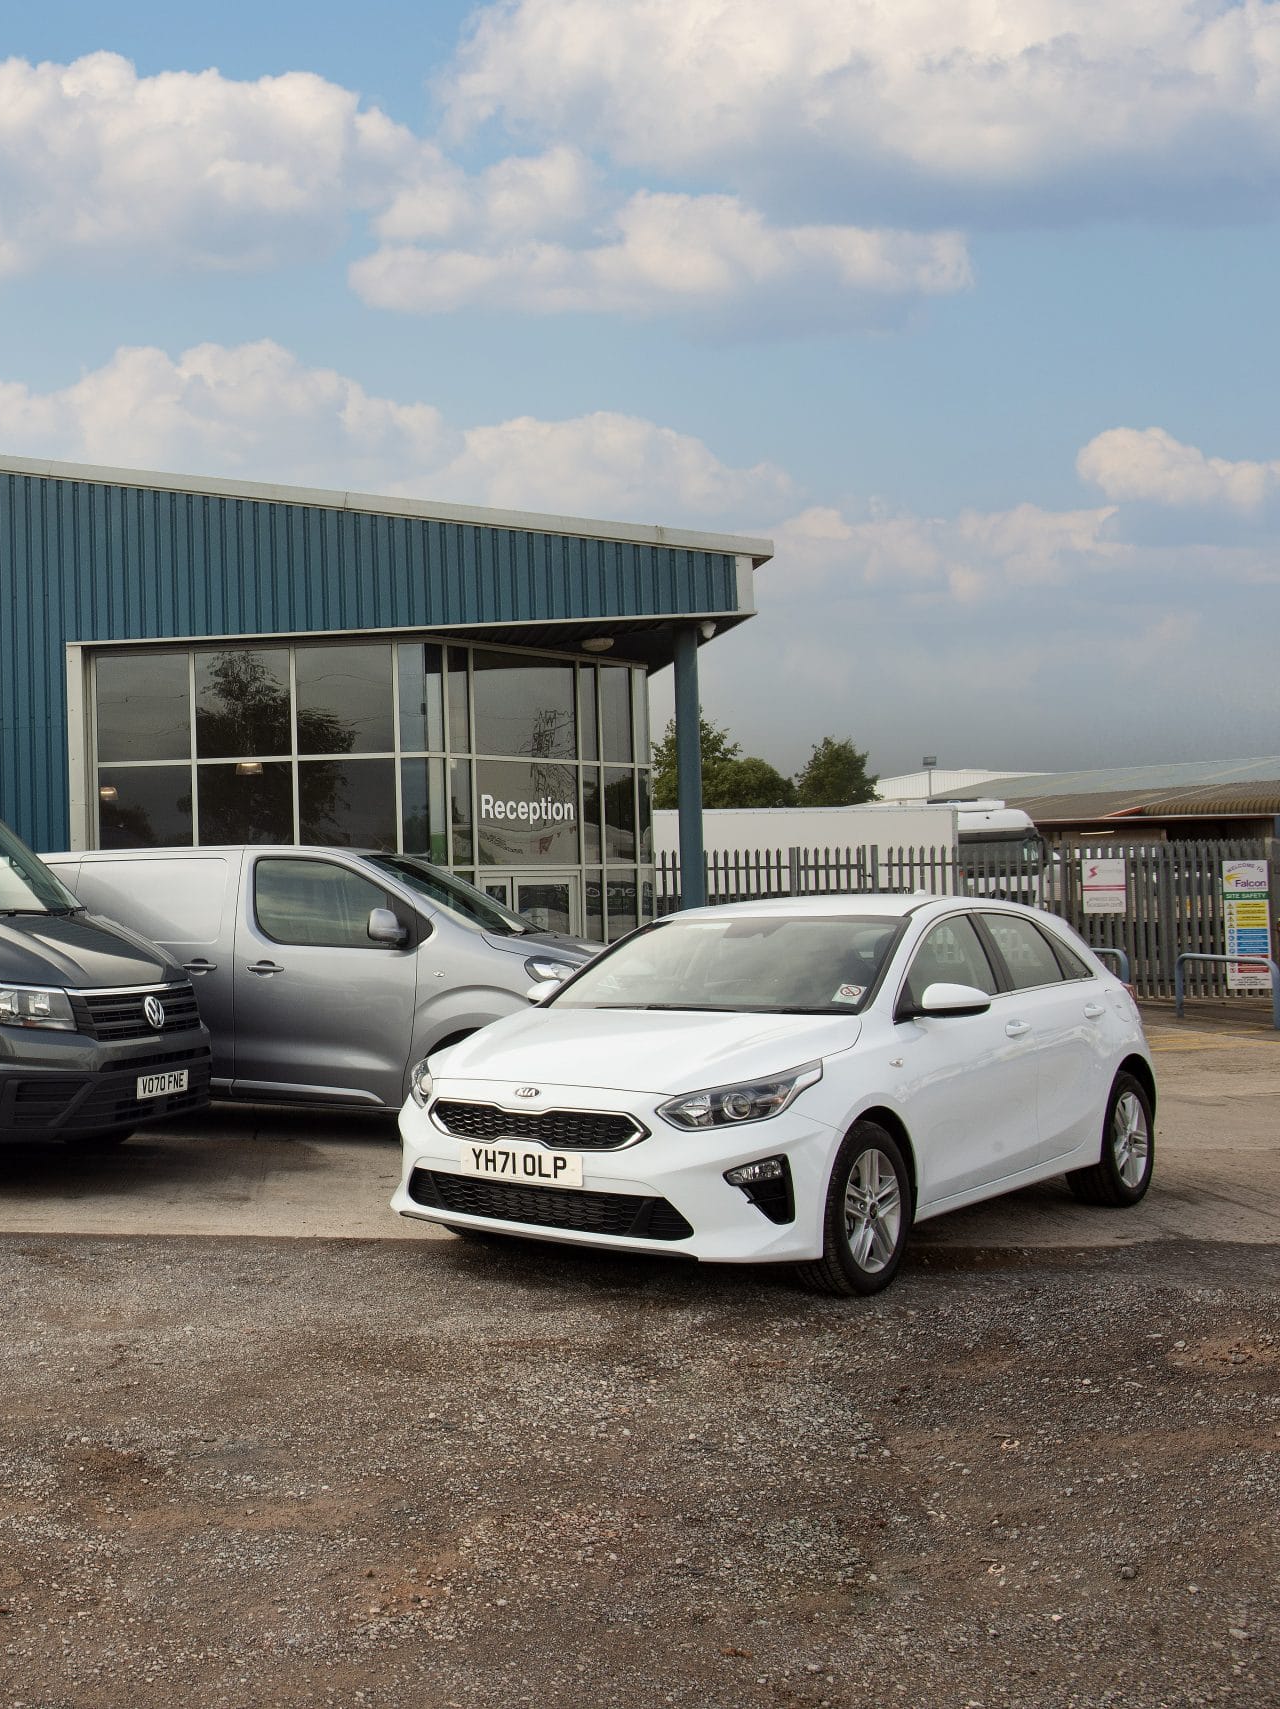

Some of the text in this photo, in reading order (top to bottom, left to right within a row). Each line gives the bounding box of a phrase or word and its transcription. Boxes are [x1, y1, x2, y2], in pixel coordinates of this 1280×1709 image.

[480, 794, 574, 825] Reception
[1235, 879, 1267, 888] Falcon
[167, 1072, 184, 1090] FNE
[516, 1087, 539, 1098] KIA
[471, 1147, 567, 1179] YH71 OLP
